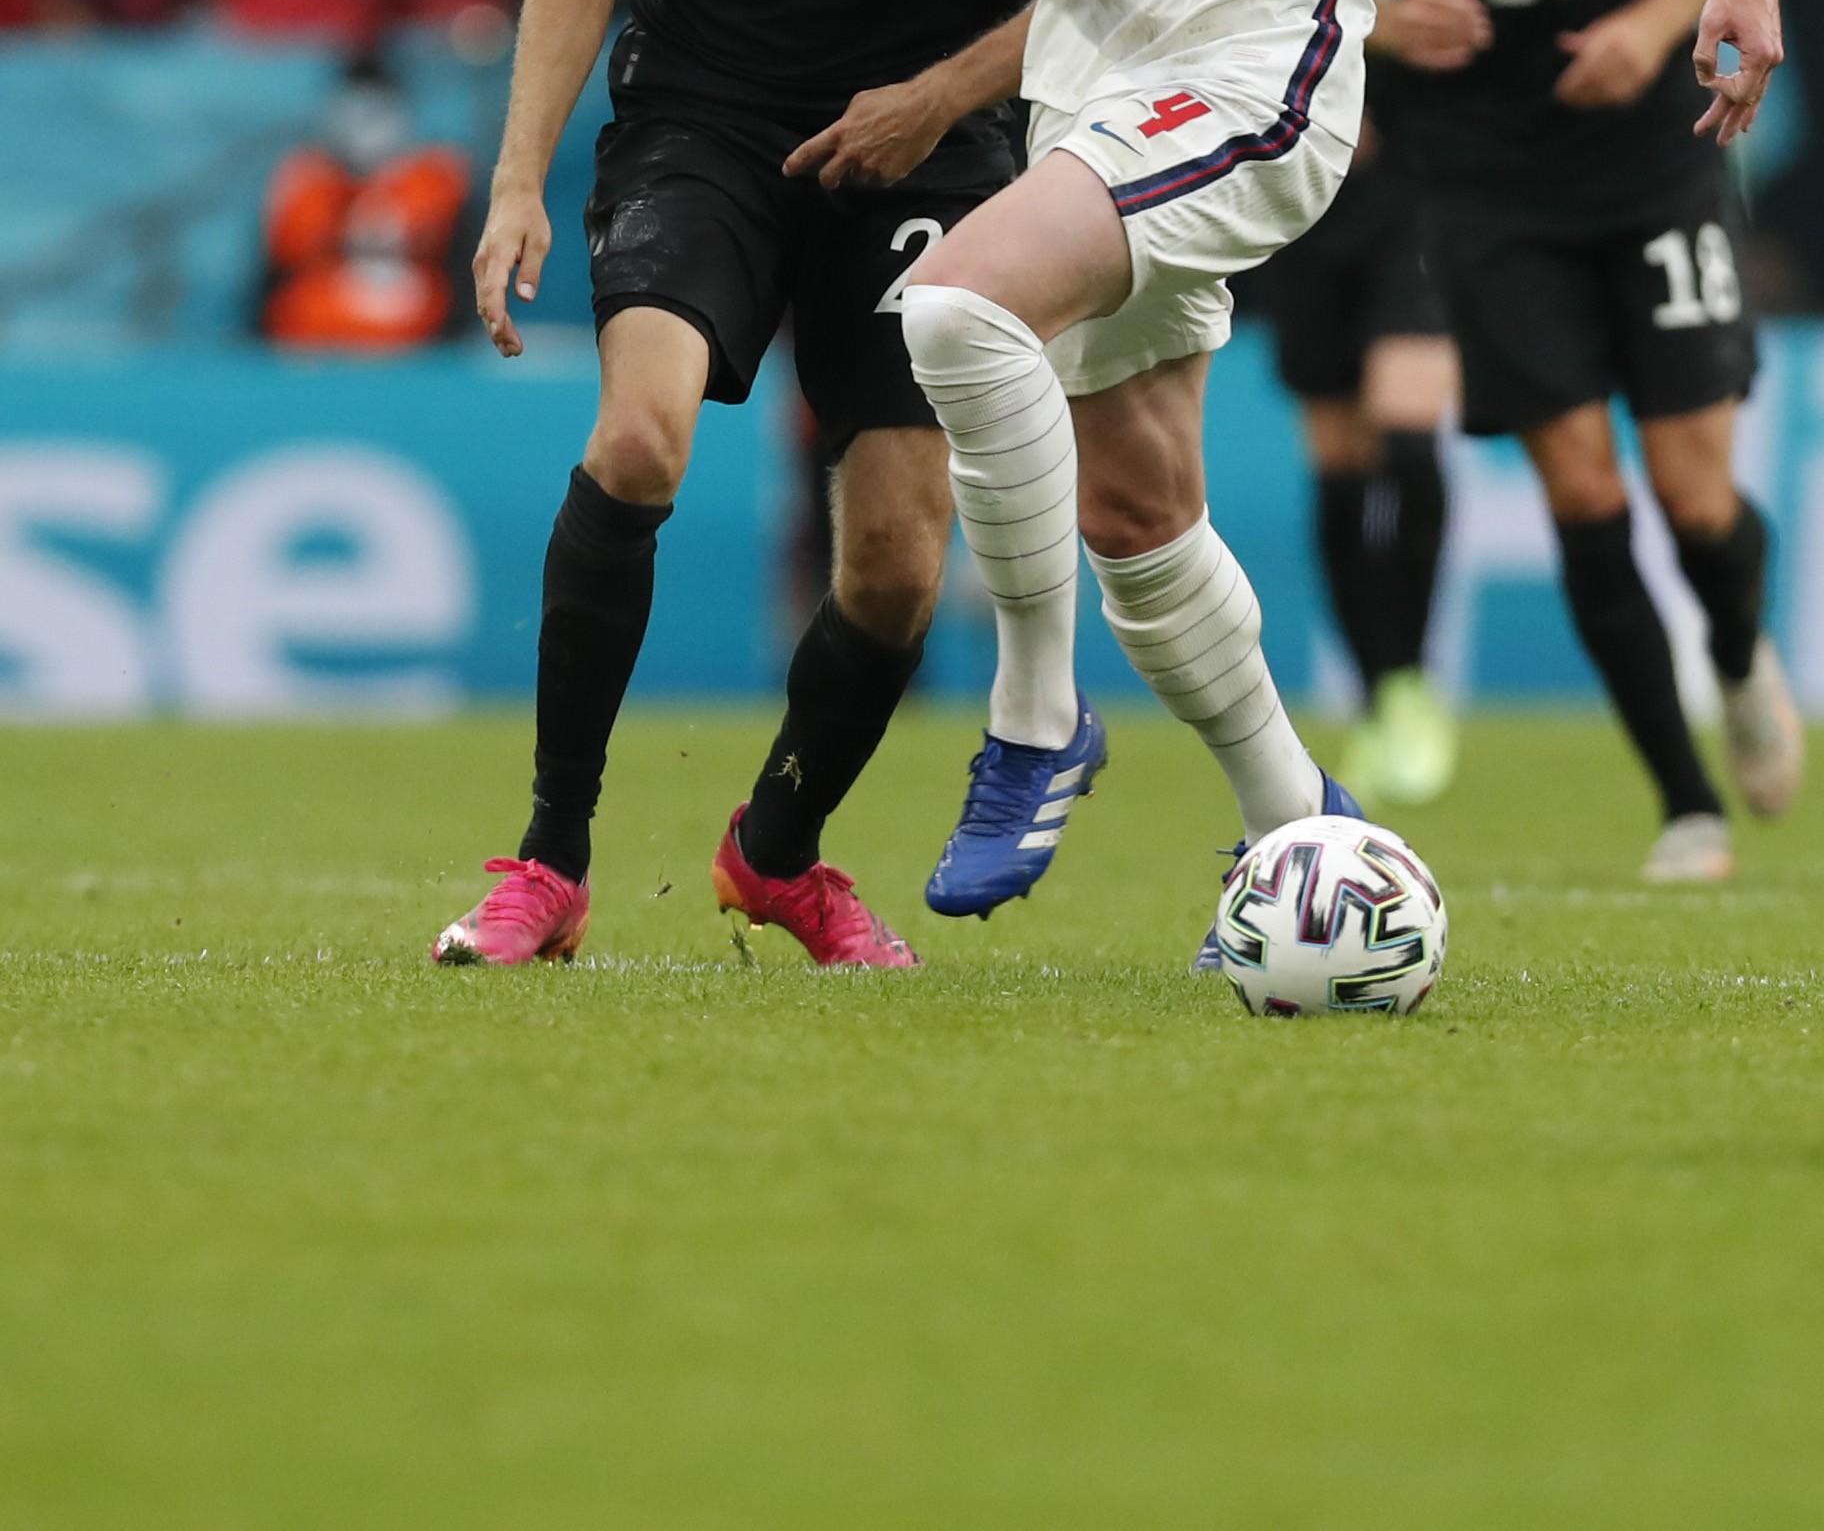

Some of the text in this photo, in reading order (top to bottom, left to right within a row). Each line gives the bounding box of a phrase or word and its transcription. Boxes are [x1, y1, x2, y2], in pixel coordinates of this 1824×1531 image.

[1137, 91, 1212, 138] 4
[873, 217, 944, 314] 2
[1643, 221, 1742, 330] 18
